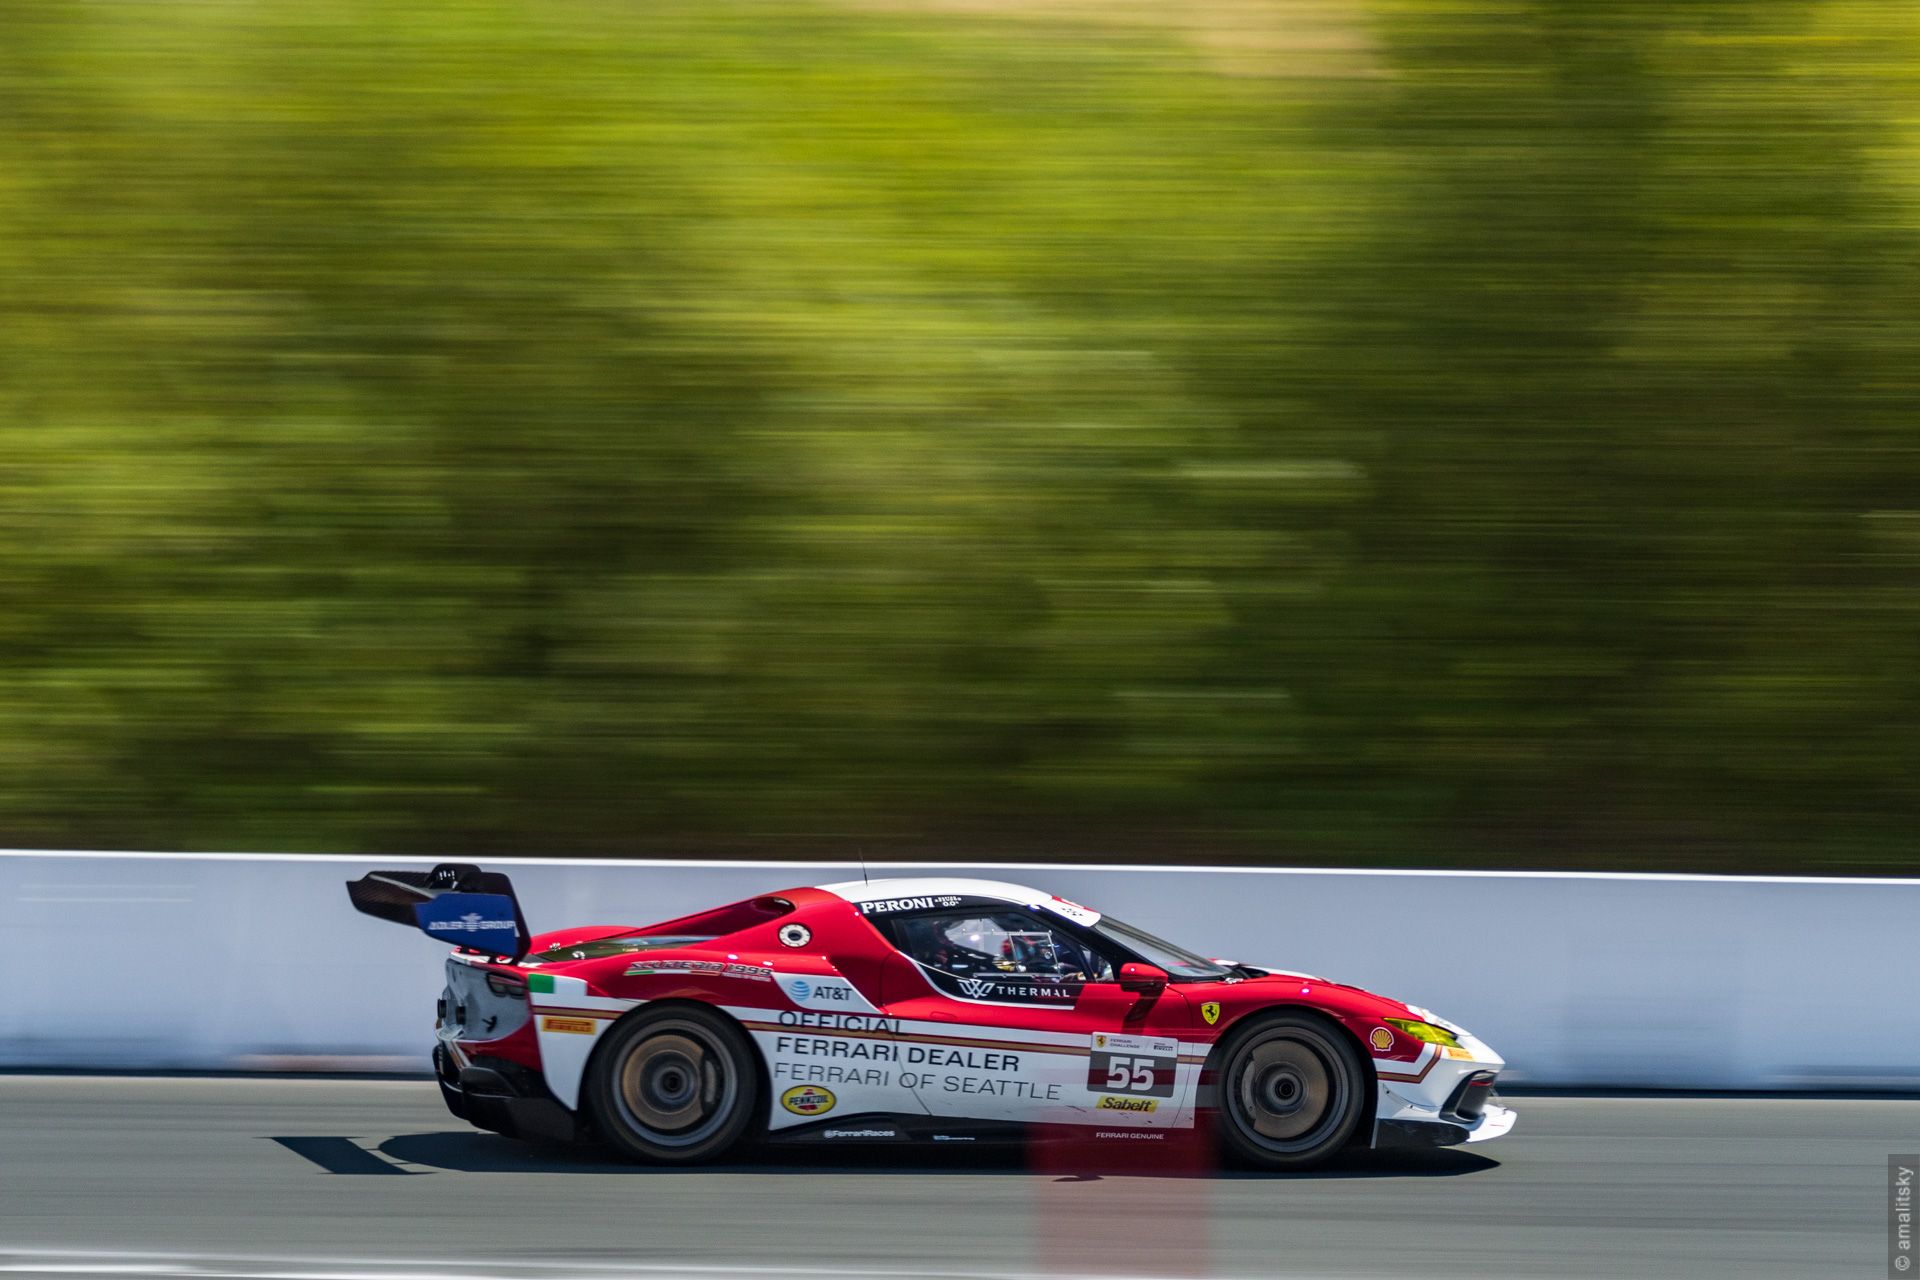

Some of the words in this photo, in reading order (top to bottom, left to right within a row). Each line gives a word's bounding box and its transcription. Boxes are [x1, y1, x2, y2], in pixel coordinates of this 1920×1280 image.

[860, 897, 935, 914] PERONI
[725, 962, 774, 977] 1999
[813, 986, 852, 1000] AT&T
[997, 986, 1070, 997] THERMAL
[779, 1011, 908, 1036] OFFICIAL
[776, 1036, 898, 1062] FERRARI
[908, 1047, 1019, 1072] DEALER
[774, 1062, 889, 1087] FERRARI
[899, 1072, 936, 1089] OF
[943, 1075, 1062, 1100] SEATTLE
[1106, 1056, 1155, 1091] 55
[1103, 1097, 1153, 1112] Sabelt
[824, 1129, 895, 1138] @FerrariRaces
